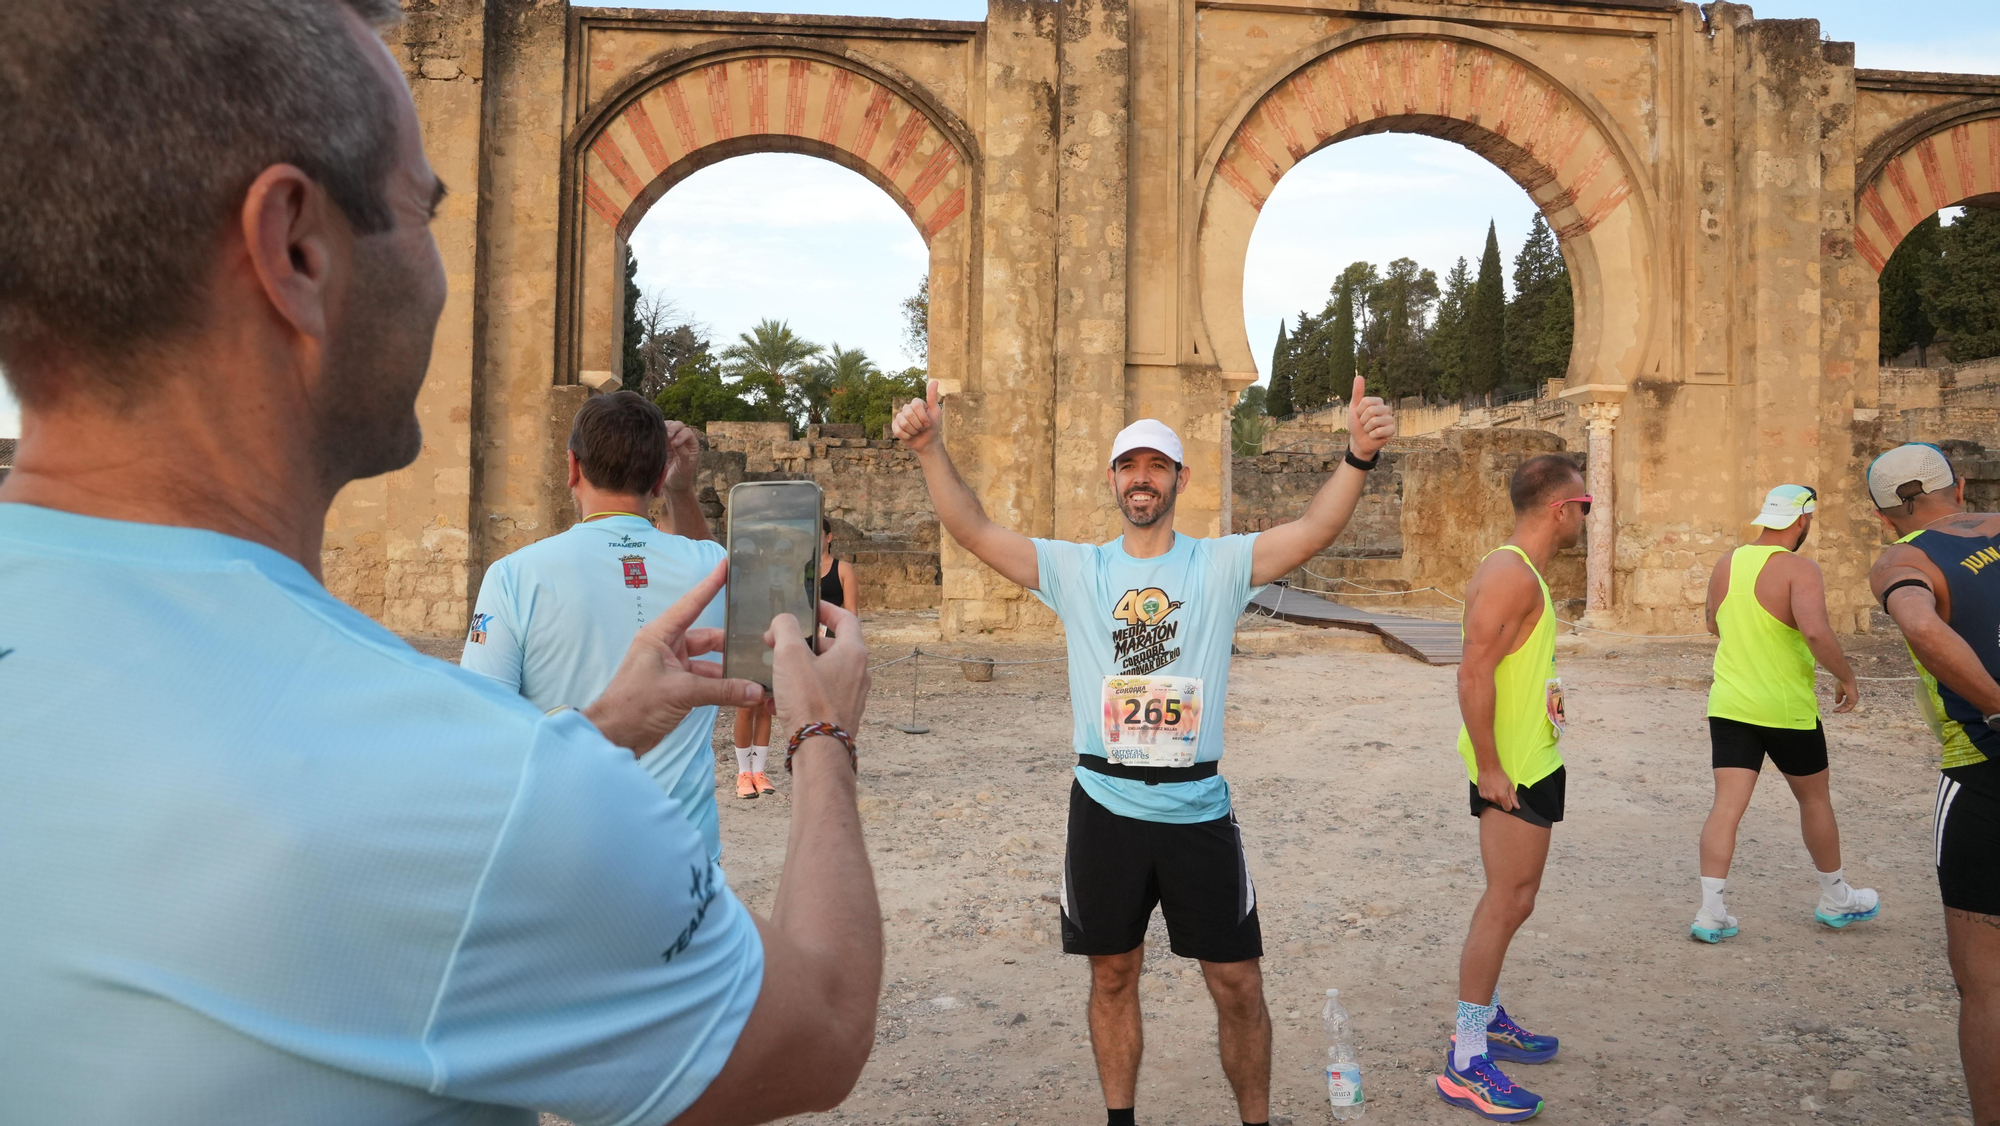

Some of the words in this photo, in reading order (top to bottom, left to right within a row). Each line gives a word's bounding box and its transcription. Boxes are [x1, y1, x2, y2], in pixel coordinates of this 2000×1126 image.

[608, 541, 647, 549] TEAMERGY
[1960, 546, 2000, 576] JUAN
[1112, 622, 1147, 643] MEDIA
[1113, 620, 1178, 664] MARATÓN
[1156, 655, 1168, 667] DEL
[1124, 698, 1182, 725] 265
